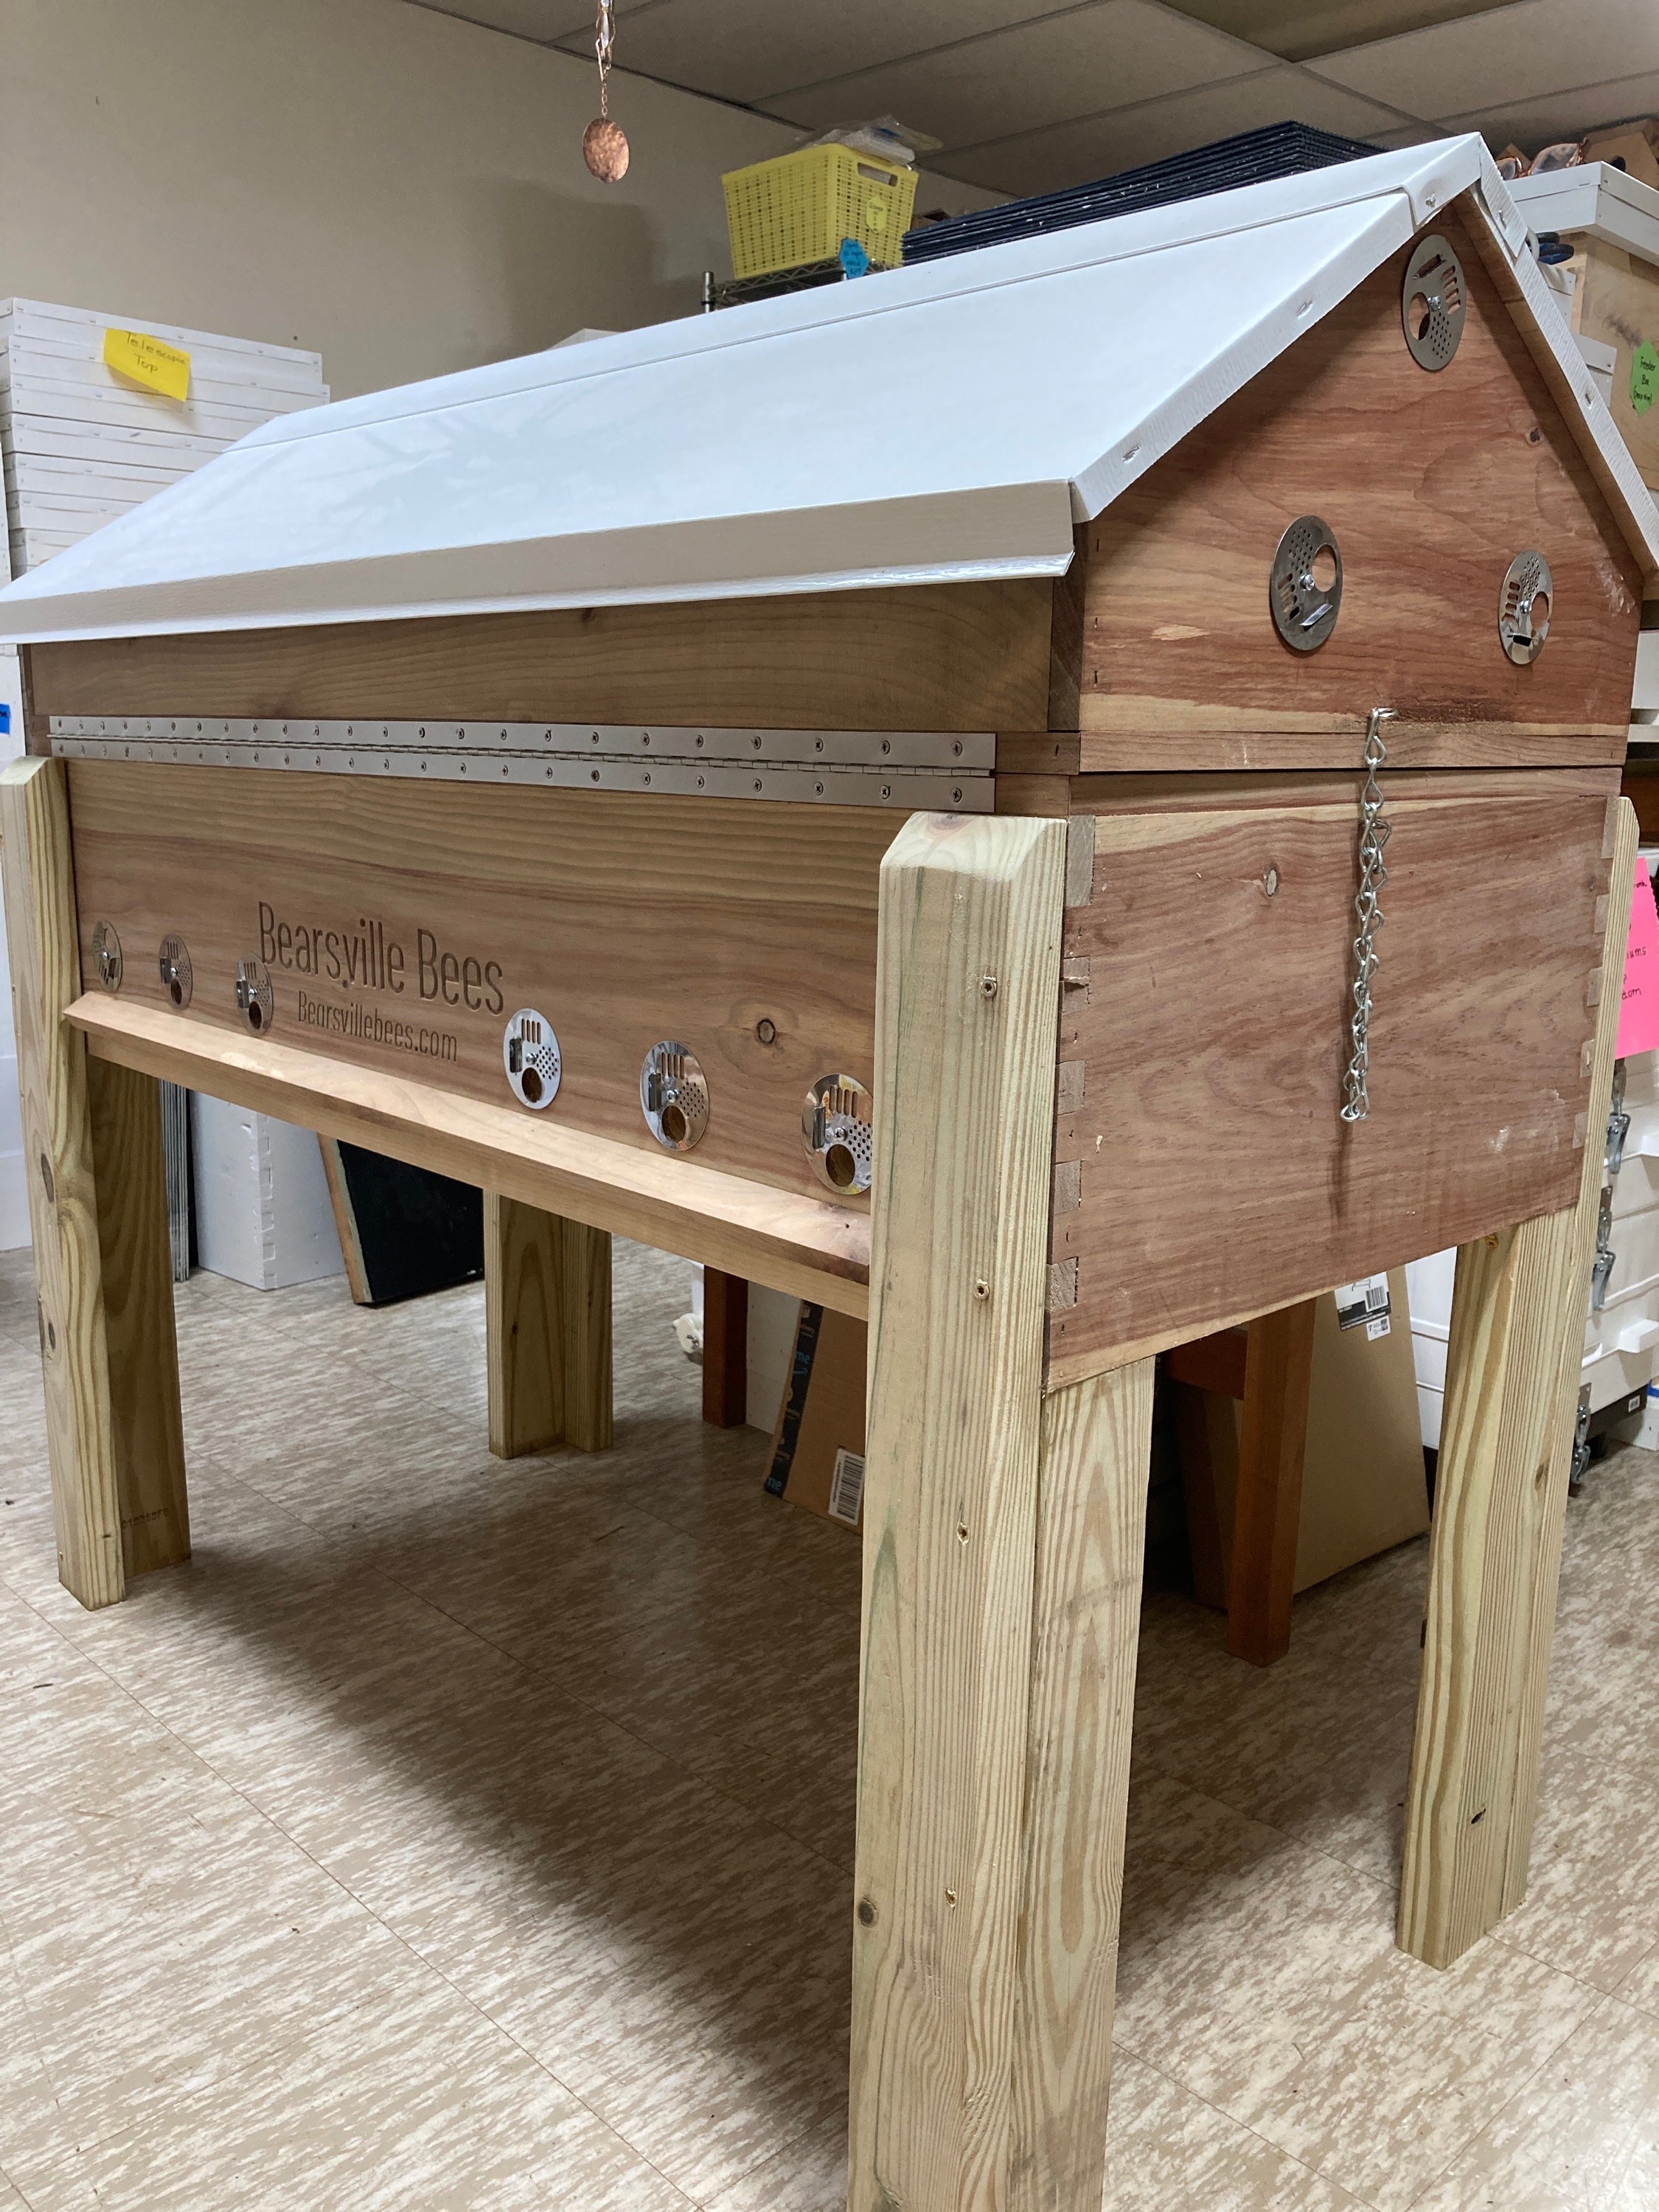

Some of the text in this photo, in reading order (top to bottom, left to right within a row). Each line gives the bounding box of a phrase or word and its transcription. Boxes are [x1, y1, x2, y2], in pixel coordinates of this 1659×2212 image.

[133, 353, 159, 373] Top
[259, 901, 504, 1015] Bearsville Bees
[298, 990, 457, 1062] Bearsvillebees.com
